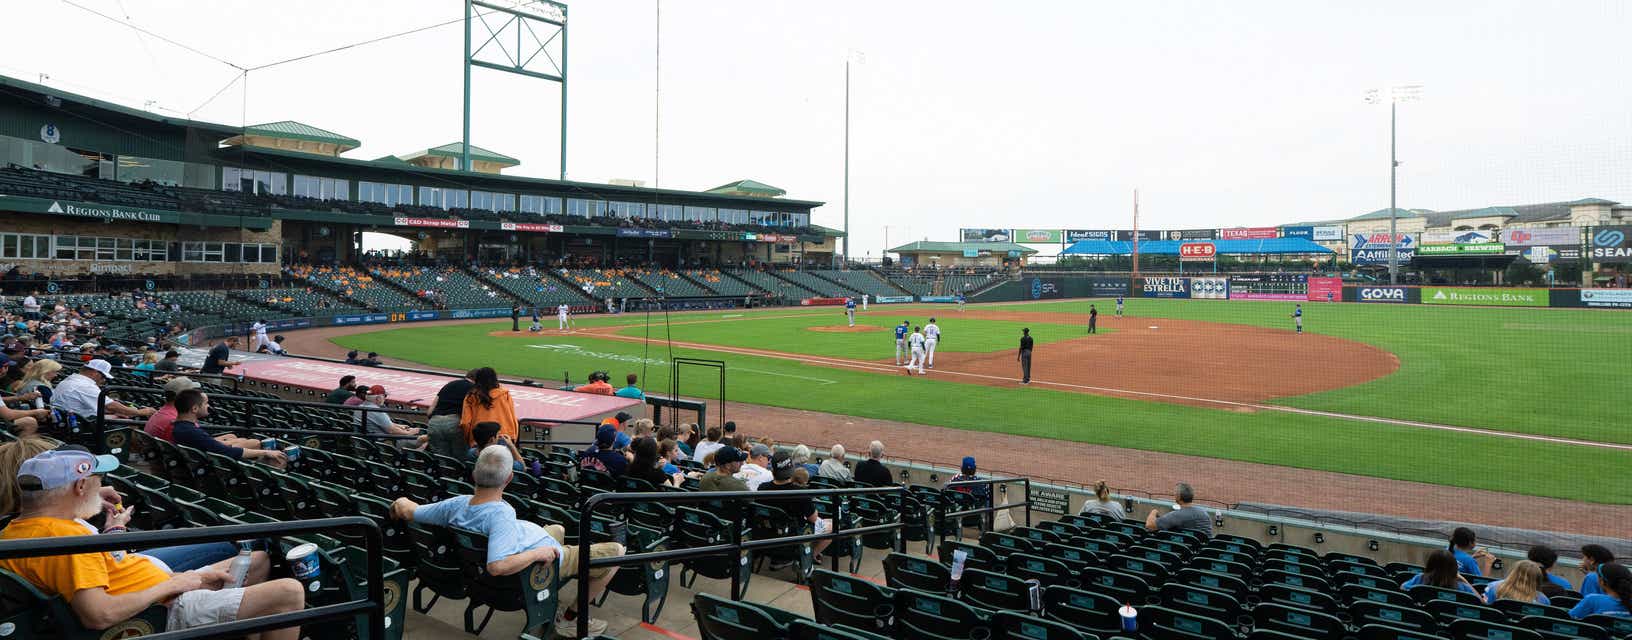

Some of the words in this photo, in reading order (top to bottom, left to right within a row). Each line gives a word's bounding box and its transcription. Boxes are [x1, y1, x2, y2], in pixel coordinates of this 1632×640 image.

[66, 205, 111, 218] REGIONS
[112, 209, 137, 220] BANK
[138, 211, 161, 221] CLUB
[1367, 249, 1415, 260] Affilted
[1143, 284, 1185, 292] ESTRELLA
[1360, 288, 1405, 299] GOYA
[1450, 292, 1499, 301] REGIONS
[1502, 293, 1535, 302] BANK
